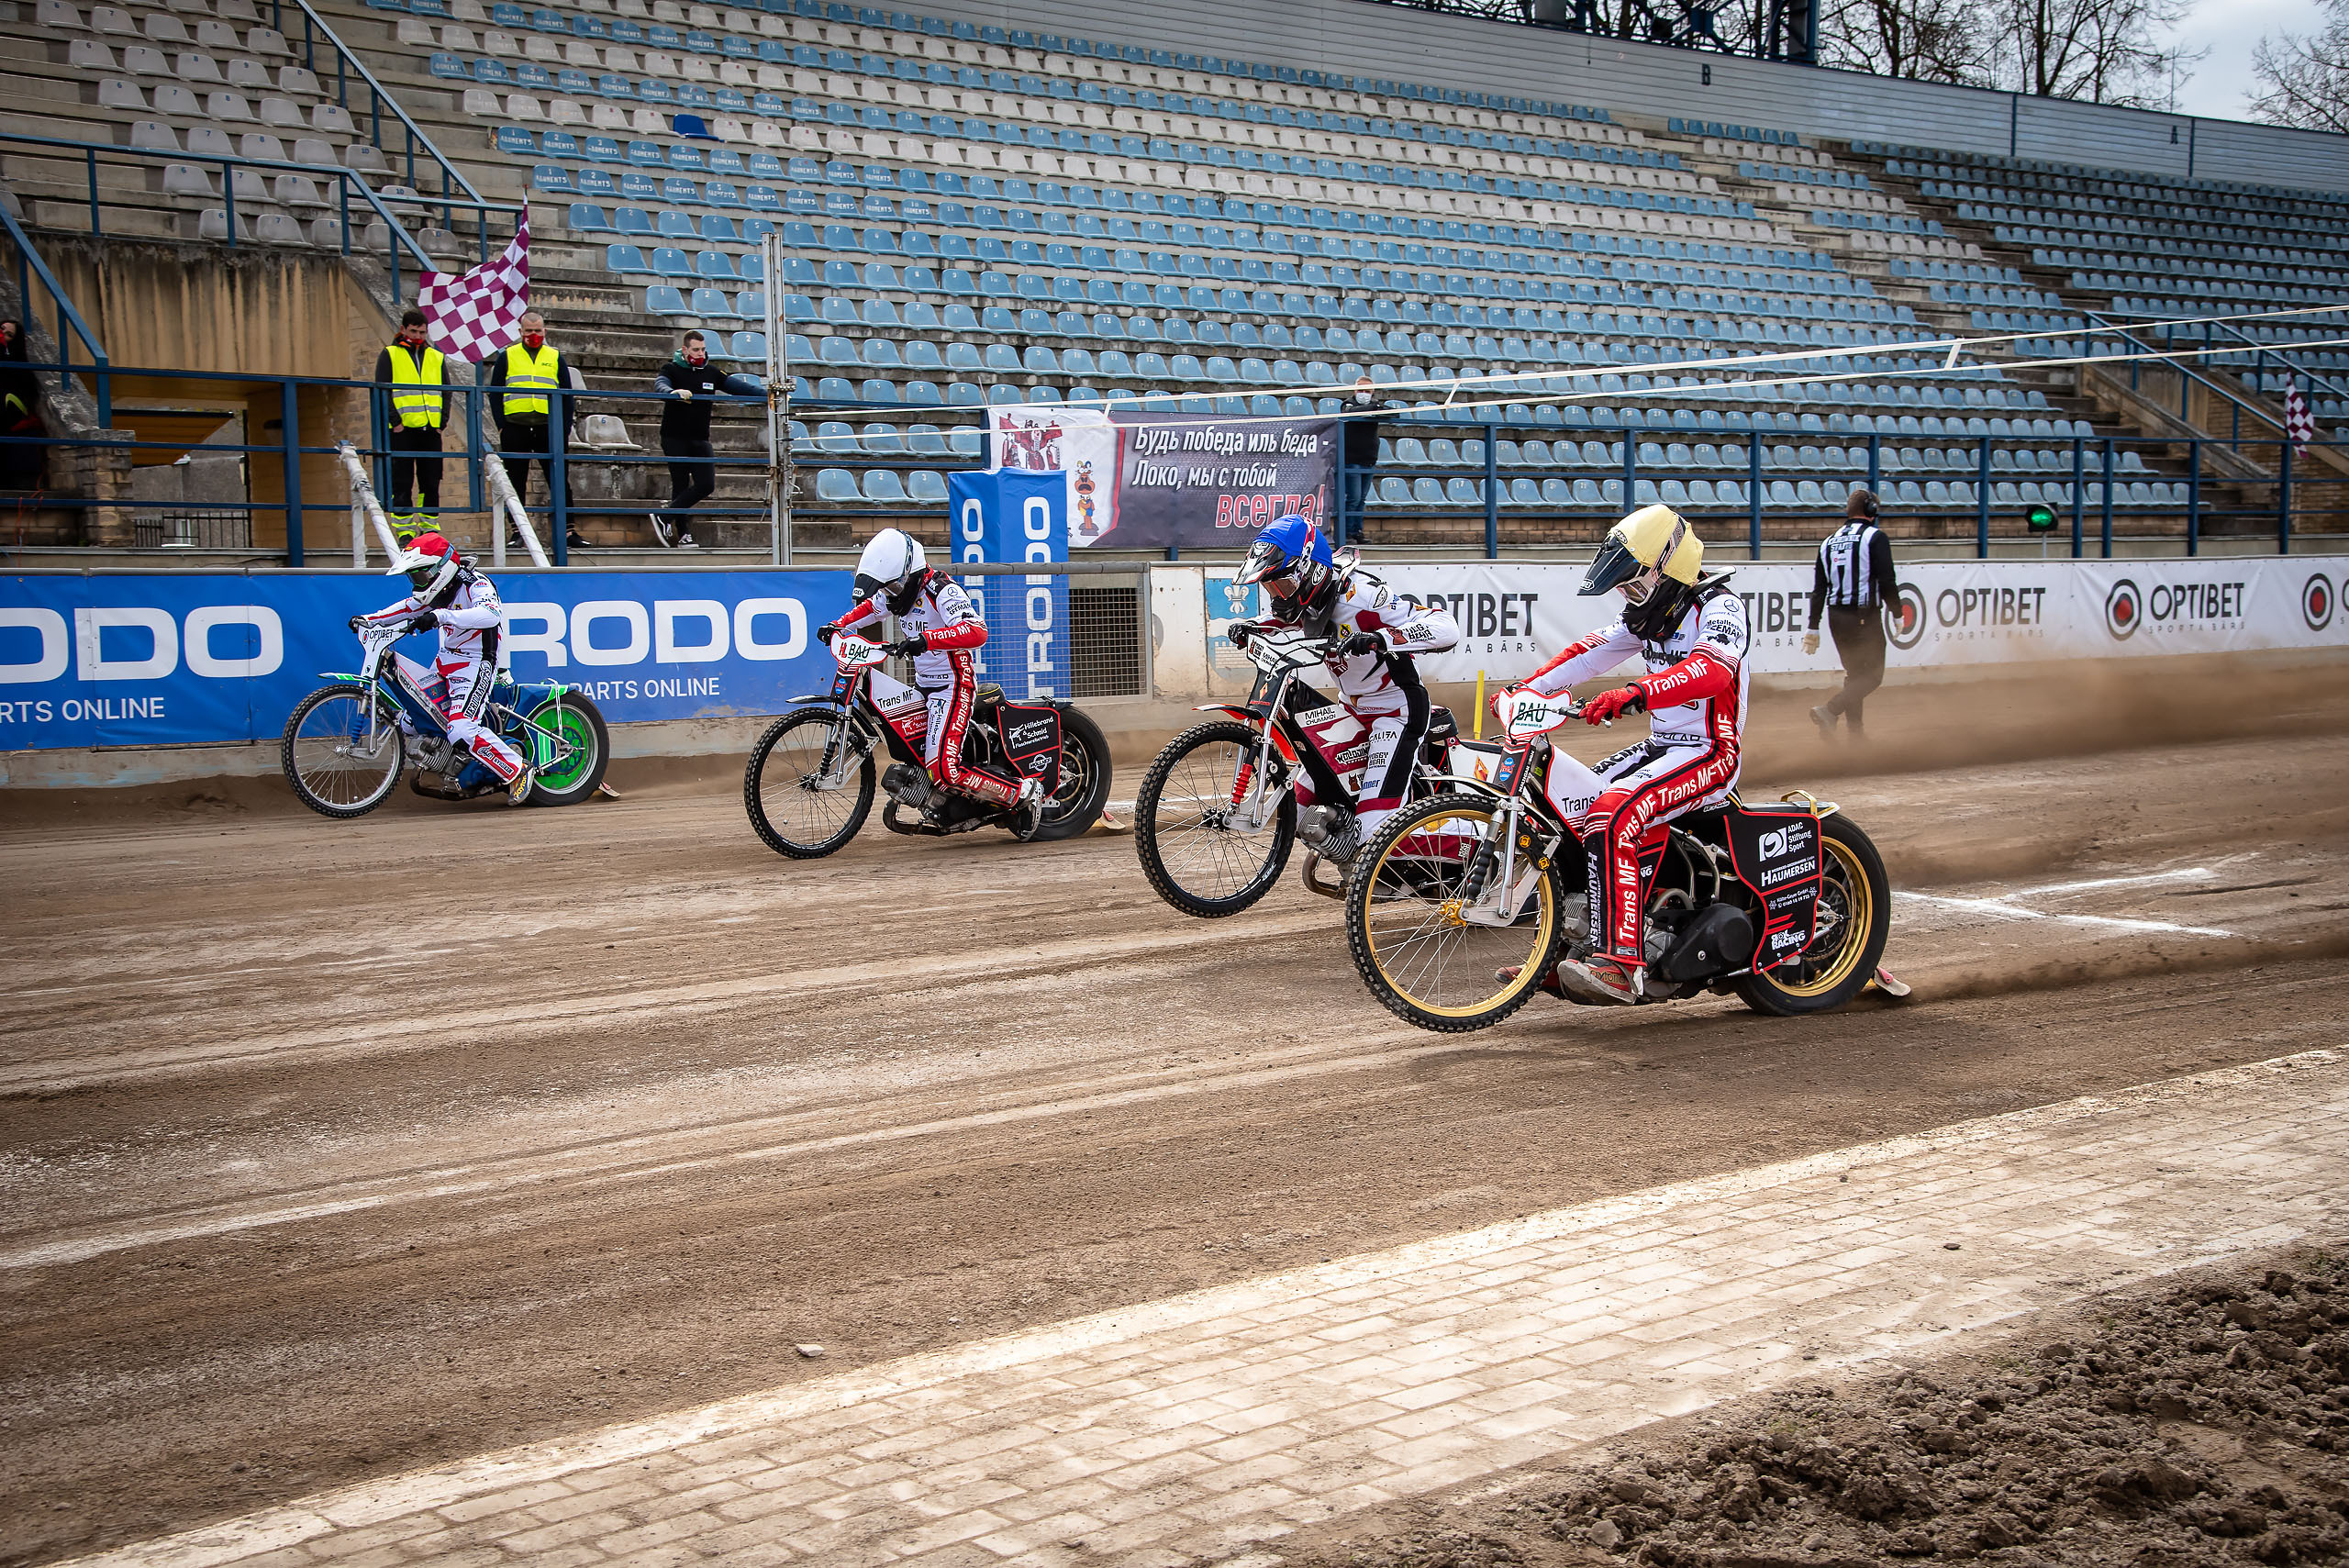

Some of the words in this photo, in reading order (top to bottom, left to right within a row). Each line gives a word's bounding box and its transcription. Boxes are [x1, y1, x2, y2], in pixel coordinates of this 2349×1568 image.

[1135, 426, 1179, 457] Будь
[1183, 428, 1243, 454] победа
[1246, 432, 1278, 453] иль
[1281, 428, 1317, 457] беда
[1131, 460, 1183, 491] Локо,
[1186, 466, 1215, 487] мы
[1218, 467, 1229, 487] с
[1231, 462, 1277, 488] тобой
[1935, 587, 2046, 628] OPTIBET
[2150, 582, 2244, 621] OPTIBET
[926, 628, 957, 640] Trans
[958, 623, 971, 635] MF
[1935, 630, 1996, 642] SPORTA
[2148, 622, 2204, 635] SPORTA
[849, 643, 871, 659] BAU
[1487, 639, 1536, 652] BĀRS
[961, 653, 974, 683] Trans
[1641, 672, 1689, 697] Trans
[1687, 658, 1709, 679] MF
[644, 677, 719, 697] ONLINE
[61, 696, 165, 720] ONLINE
[877, 695, 901, 709] Trans
[902, 689, 914, 702] MF
[952, 704, 971, 733] Trans
[963, 687, 971, 706] MF
[1305, 707, 1335, 720] MIHAIL
[1517, 702, 1547, 723] BAU
[1023, 716, 1054, 730] Hillebrand
[1027, 727, 1048, 739] Schmid
[1717, 713, 1736, 741] MF
[947, 738, 960, 755] MF
[963, 773, 983, 788] MF
[1657, 778, 1698, 807] Trans
[1697, 767, 1719, 790] MF
[1562, 795, 1596, 813] Trans
[1619, 814, 1640, 850] Trans
[1635, 795, 1657, 823] MF
[1787, 821, 1804, 834] ADAC
[1787, 829, 1812, 844] Stiftung
[1788, 840, 1805, 853] Sport
[1618, 857, 1637, 887] MF
[1761, 860, 1816, 887] HAUMERSEN
[1587, 851, 1599, 947] HAUMERSEN
[1619, 890, 1637, 941] Trans
[1772, 932, 1806, 951] RACING
